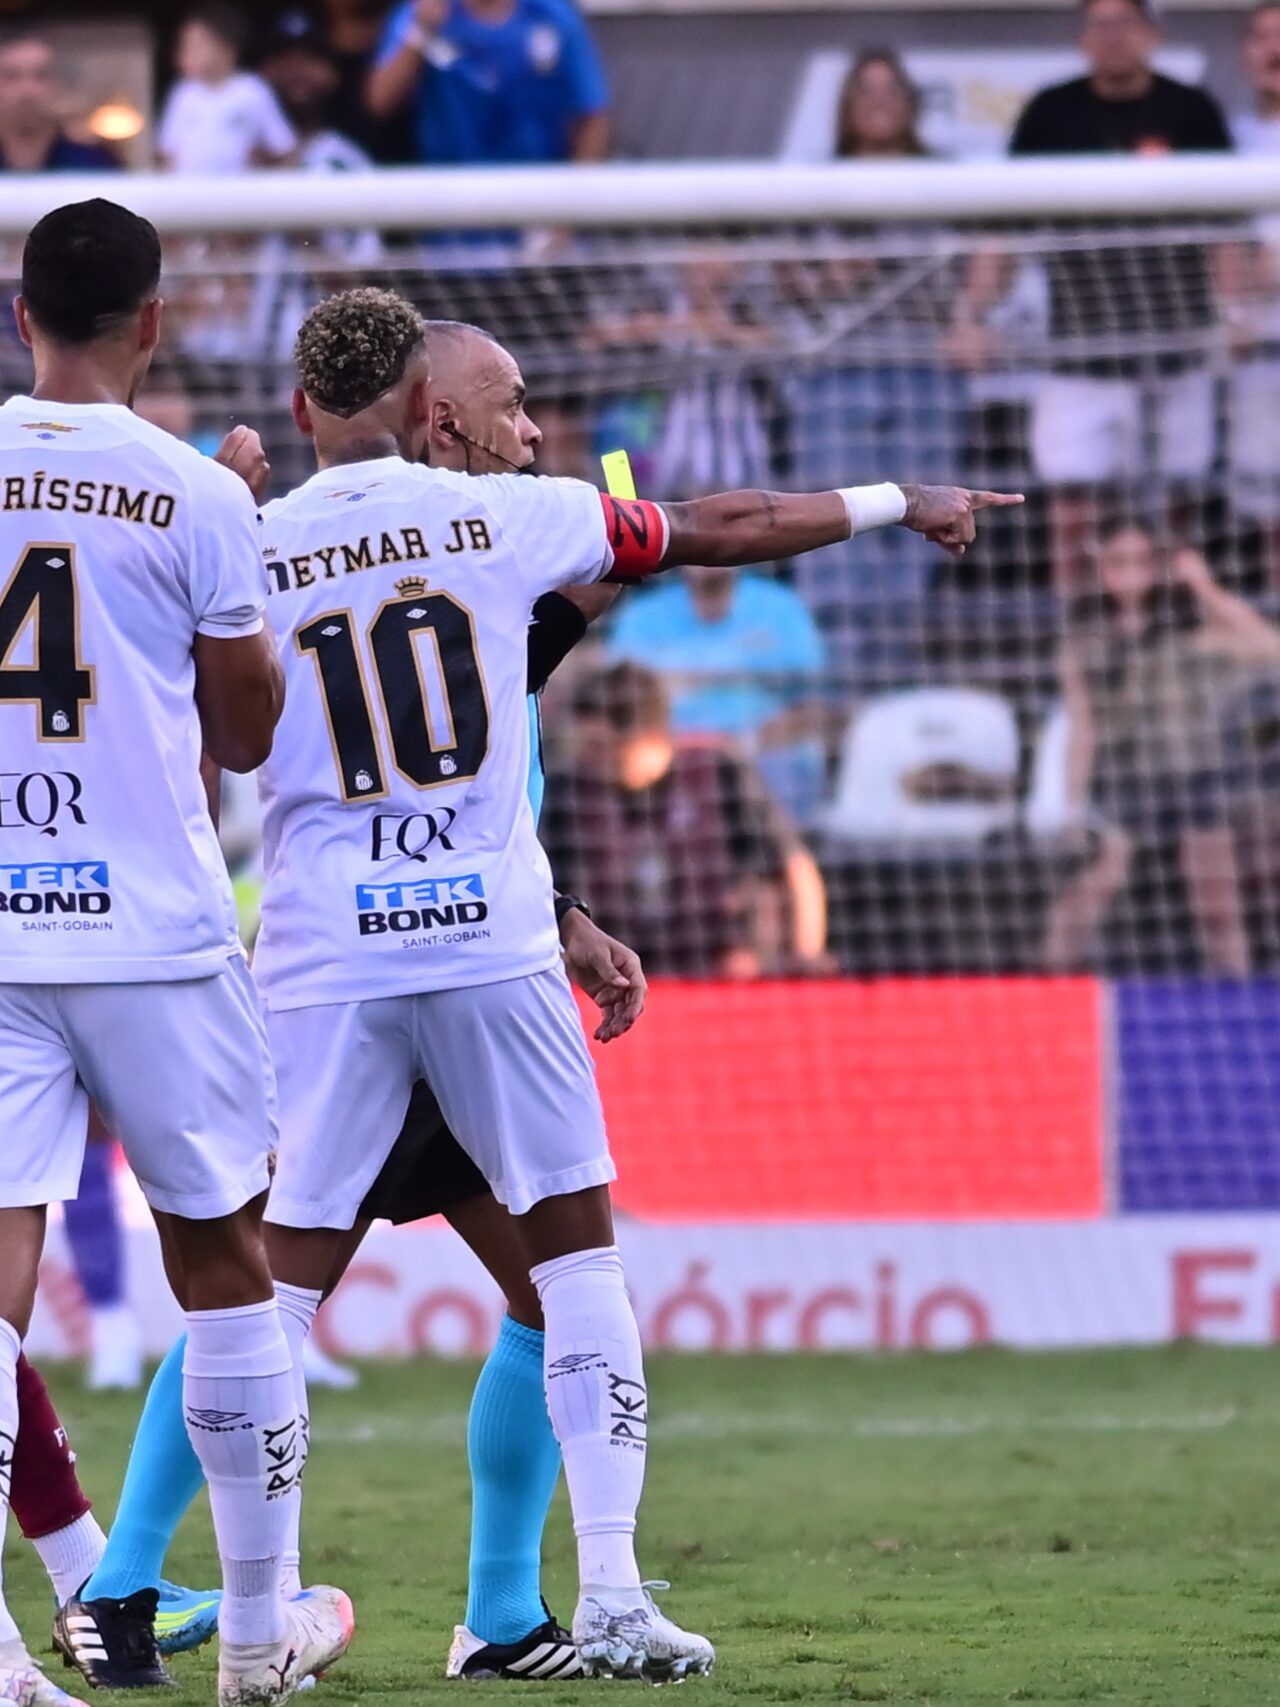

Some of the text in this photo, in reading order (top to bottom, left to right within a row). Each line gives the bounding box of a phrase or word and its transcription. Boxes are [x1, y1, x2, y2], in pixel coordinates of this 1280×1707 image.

[444, 518, 492, 554] JR
[294, 588, 491, 805] 10
[371, 806, 457, 863] EQR
[361, 877, 477, 910] TEK
[22, 920, 113, 932] SAINT-GOBAIN
[358, 901, 488, 936] BOND
[402, 929, 491, 949] SAINT-GOBAIN
[610, 1438, 645, 1451] BY NE
